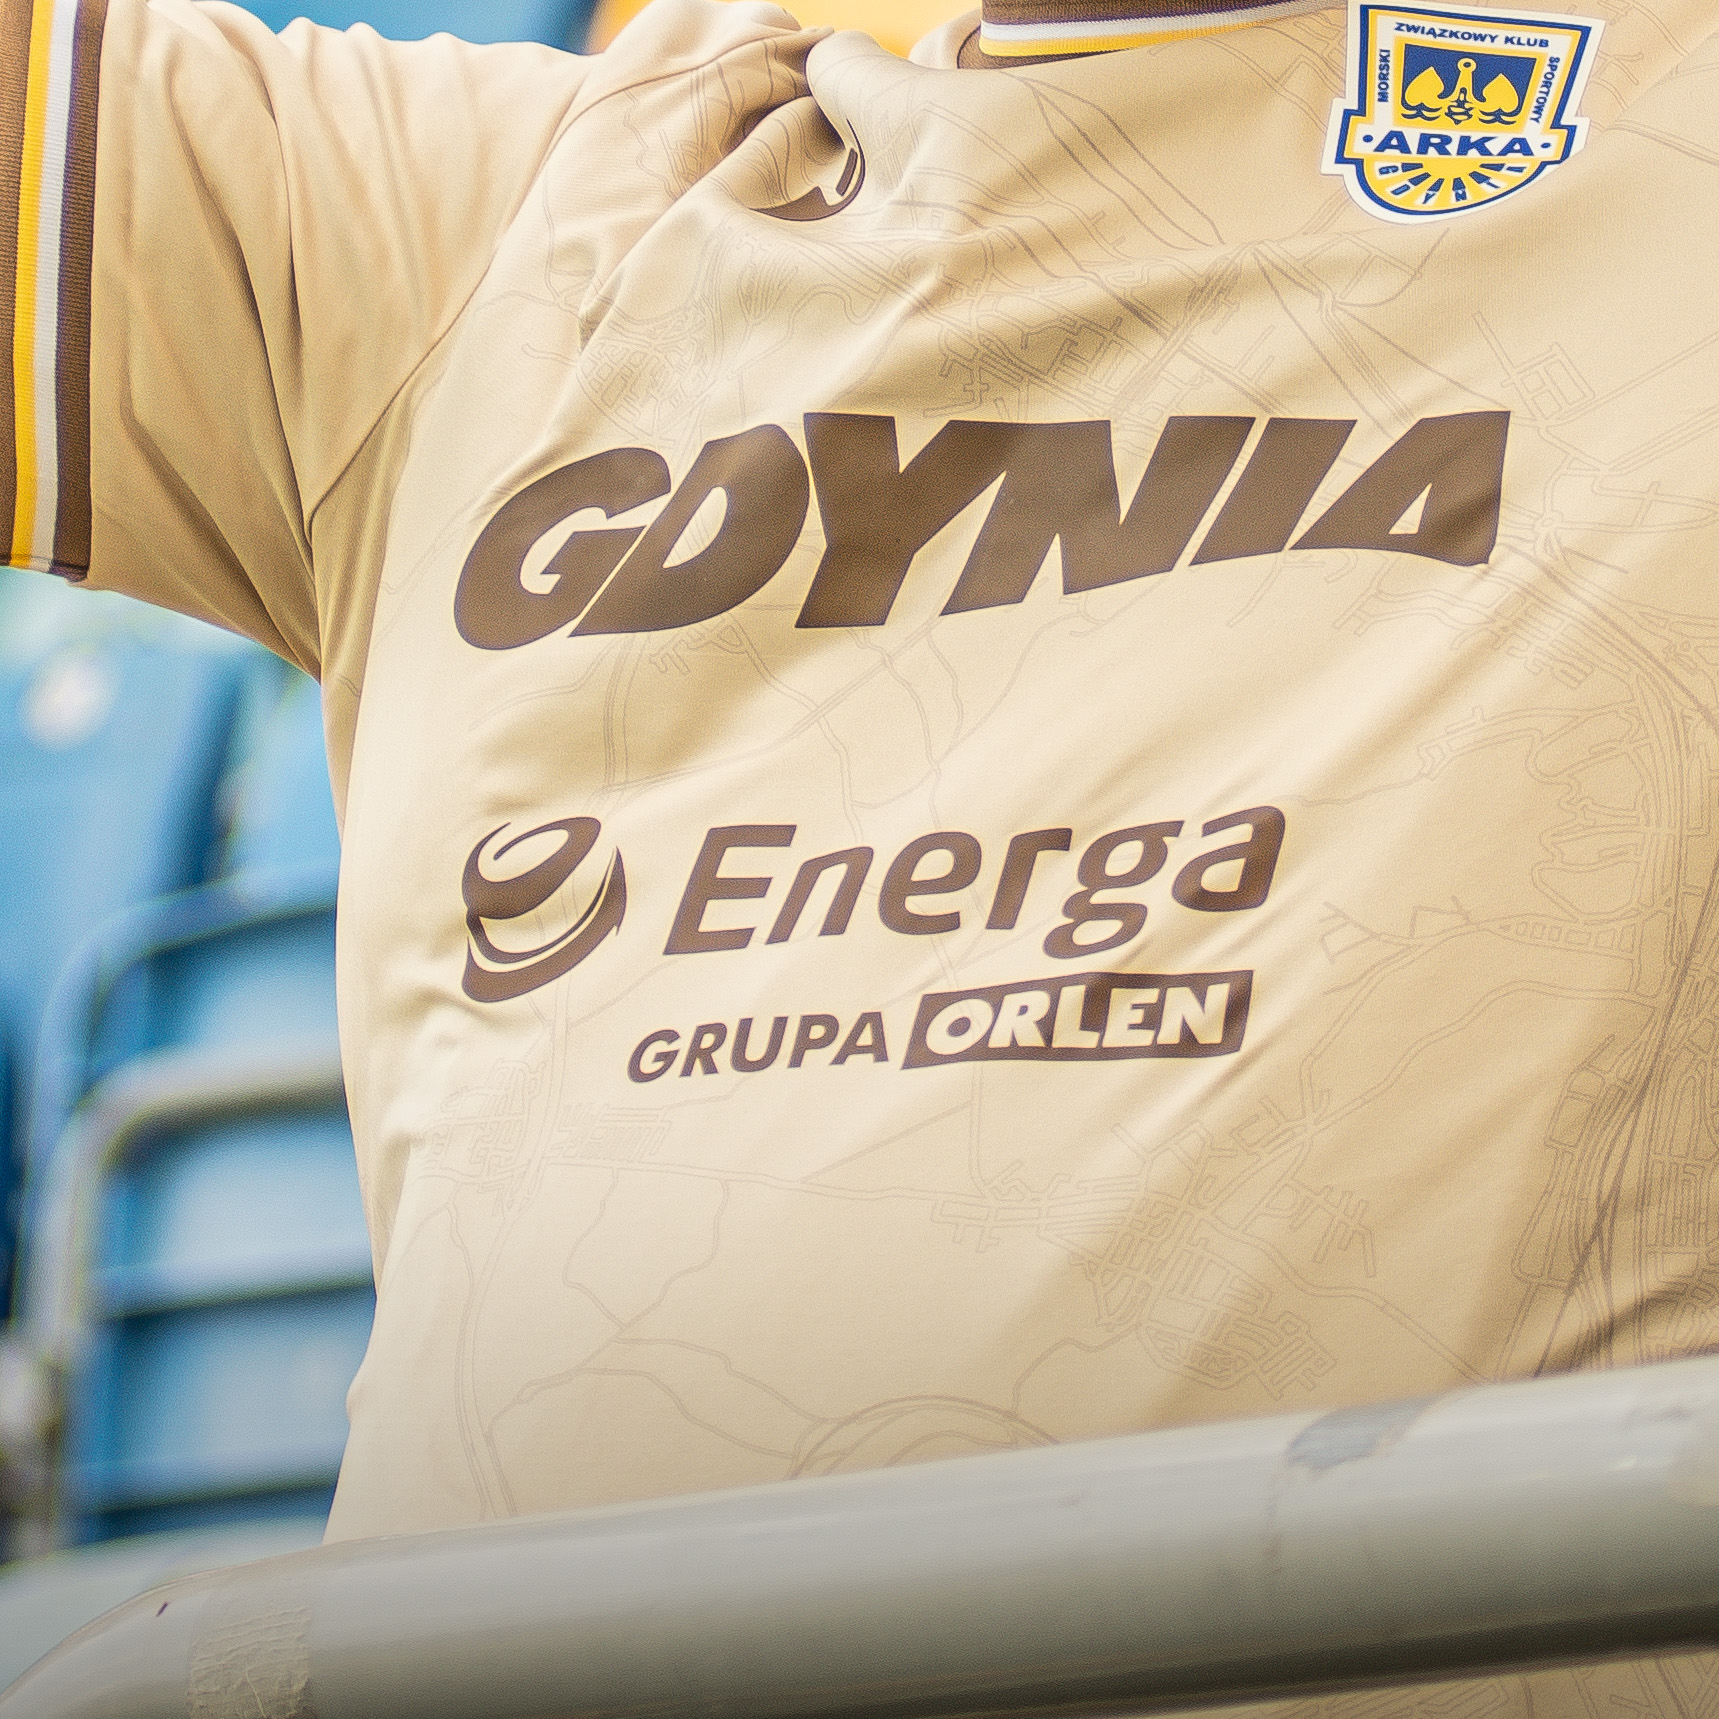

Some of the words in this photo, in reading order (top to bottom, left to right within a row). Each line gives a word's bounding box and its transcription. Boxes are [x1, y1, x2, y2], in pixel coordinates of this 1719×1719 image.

[1394, 22, 1499, 44] ZWIĄZKOWY
[1504, 35, 1550, 48] KLUB
[1377, 49, 1391, 102] MORSKI
[1529, 56, 1561, 124] SPORTOWY
[1373, 130, 1535, 156] ARKA
[454, 411, 1511, 651] GDYNIA
[662, 805, 1286, 959] Energa
[626, 1010, 890, 1083] GRUPA
[923, 981, 1234, 1056] ORLEN
